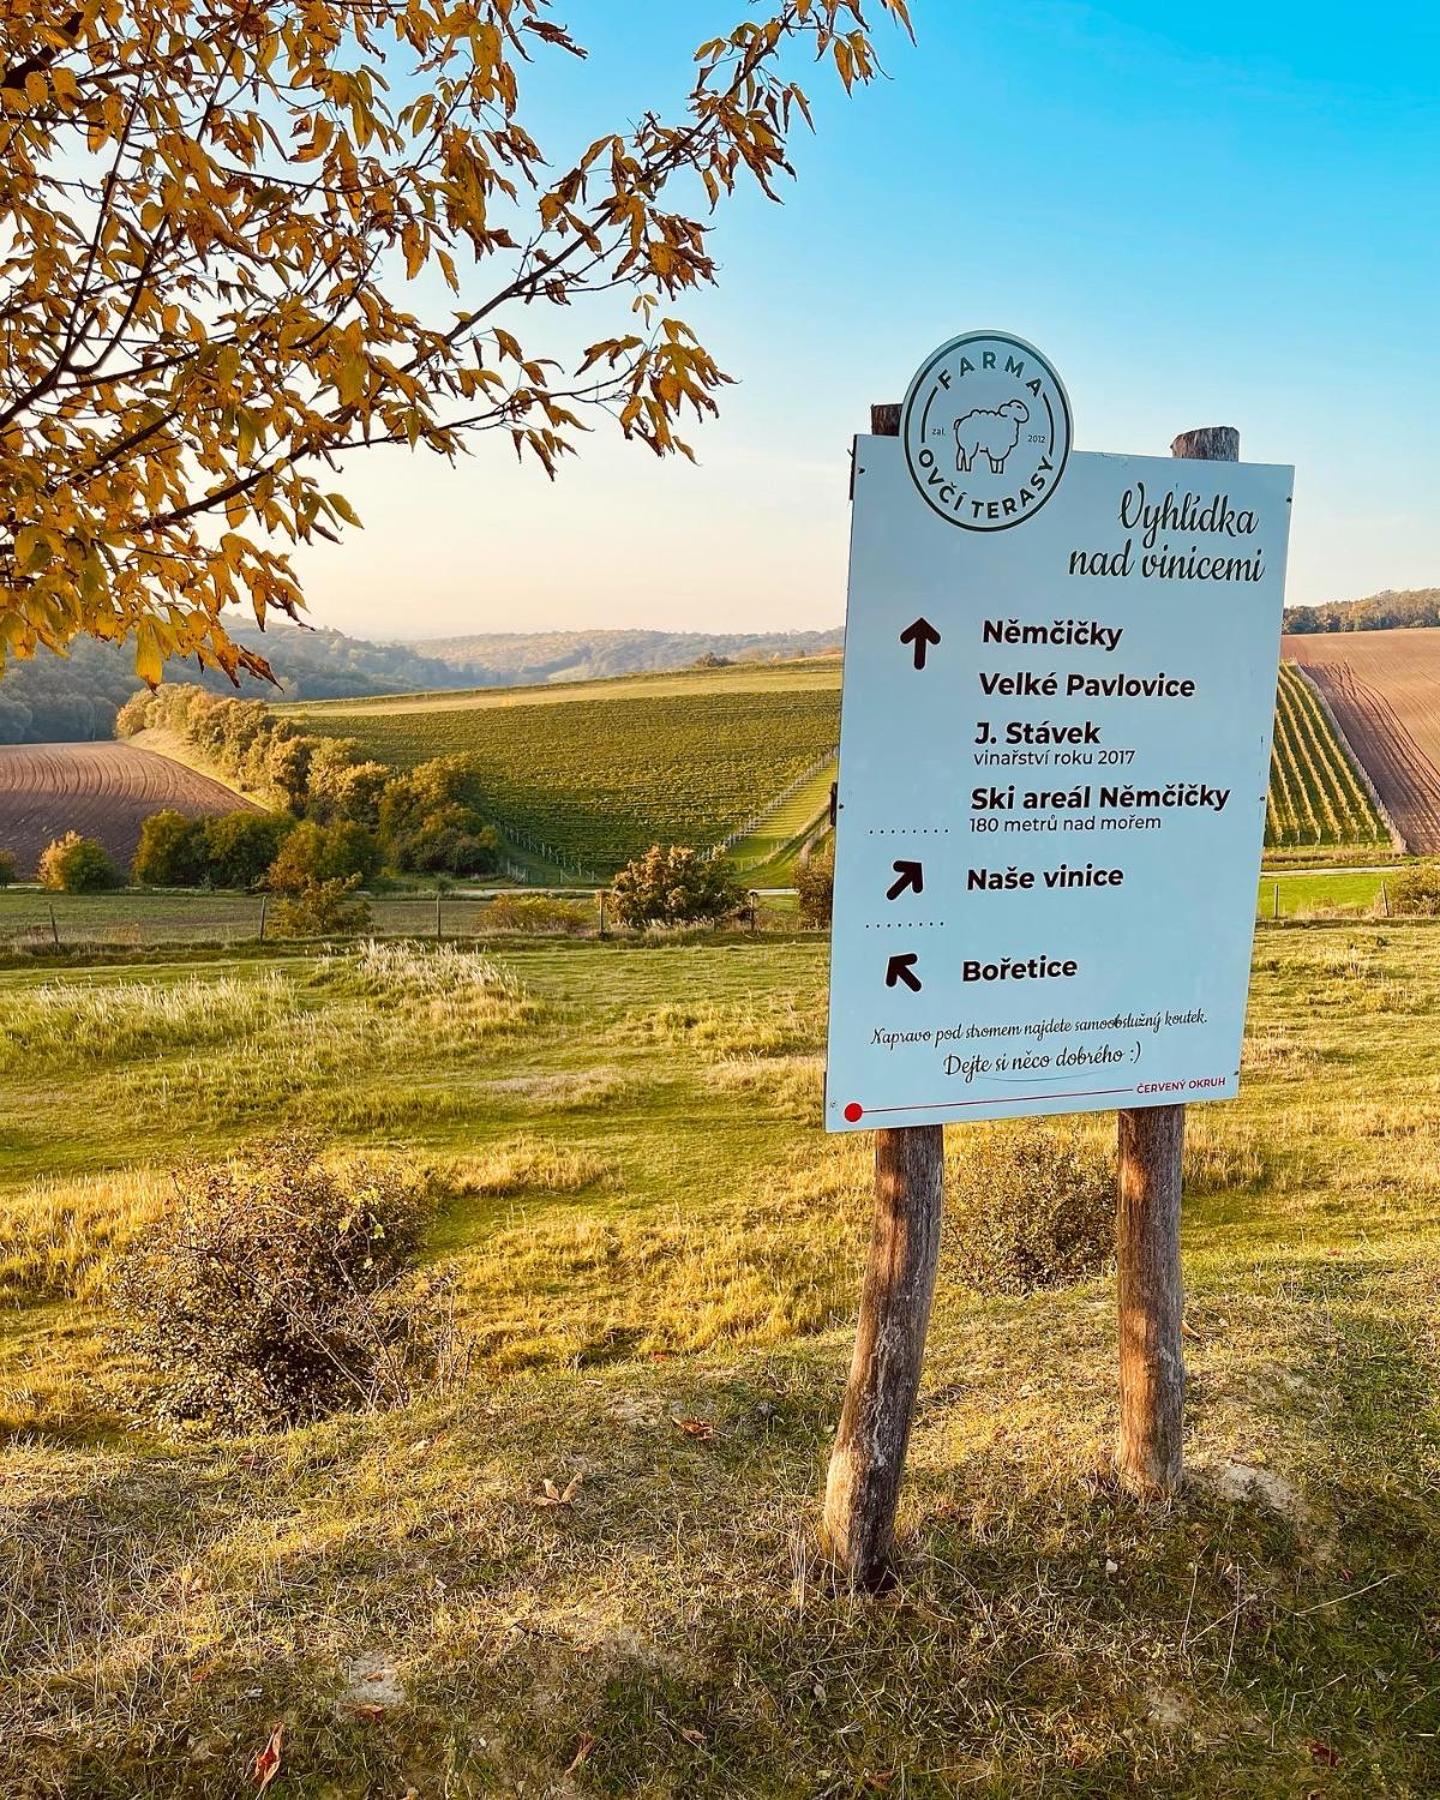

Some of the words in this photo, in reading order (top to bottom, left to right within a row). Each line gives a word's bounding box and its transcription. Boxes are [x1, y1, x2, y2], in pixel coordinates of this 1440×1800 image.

[937, 351, 1043, 397] FARMA
[1027, 434, 1046, 444] 2012
[918, 449, 968, 511] OVČÍ
[971, 455, 1054, 519] TERASY
[1118, 482, 1259, 549] Vyhlídka
[1069, 538, 1135, 577] nad
[1141, 544, 1265, 582] vinicemi
[982, 619, 1124, 651] Němčičky
[979, 671, 1058, 696] Velké
[1066, 672, 1195, 697] Pavlovice
[974, 722, 997, 744] J.
[1005, 720, 1101, 744] Stávek
[974, 750, 1050, 766] vinařství
[1054, 750, 1093, 765] roku
[1097, 750, 1135, 765] 2017
[971, 785, 1015, 810] Ski
[1023, 785, 1091, 809] areál
[1100, 783, 1231, 812] Němčičky
[970, 818, 999, 832] 180
[1004, 814, 1057, 832] metrů
[1063, 815, 1095, 831] nad
[1100, 815, 1161, 830] mořem
[967, 865, 1035, 891] Naše
[1043, 863, 1124, 888] vinice
[962, 954, 1078, 982] Bořetice
[870, 1027, 931, 1050] Napravo
[934, 1023, 964, 1048] pod
[965, 1023, 1021, 1039] stromem
[1023, 1017, 1072, 1041] najdete
[1074, 1011, 1162, 1033] samoobslužný
[1164, 1007, 1208, 1027] koutek.
[943, 1053, 992, 1083] Dejte
[995, 1052, 1009, 1072] si
[1012, 1050, 1052, 1070] něco
[1055, 1042, 1125, 1067] dobrého
[1129, 1041, 1142, 1064] :)
[1136, 1079, 1186, 1095] ČERVENÝ
[1188, 1077, 1226, 1089] OKRUH
